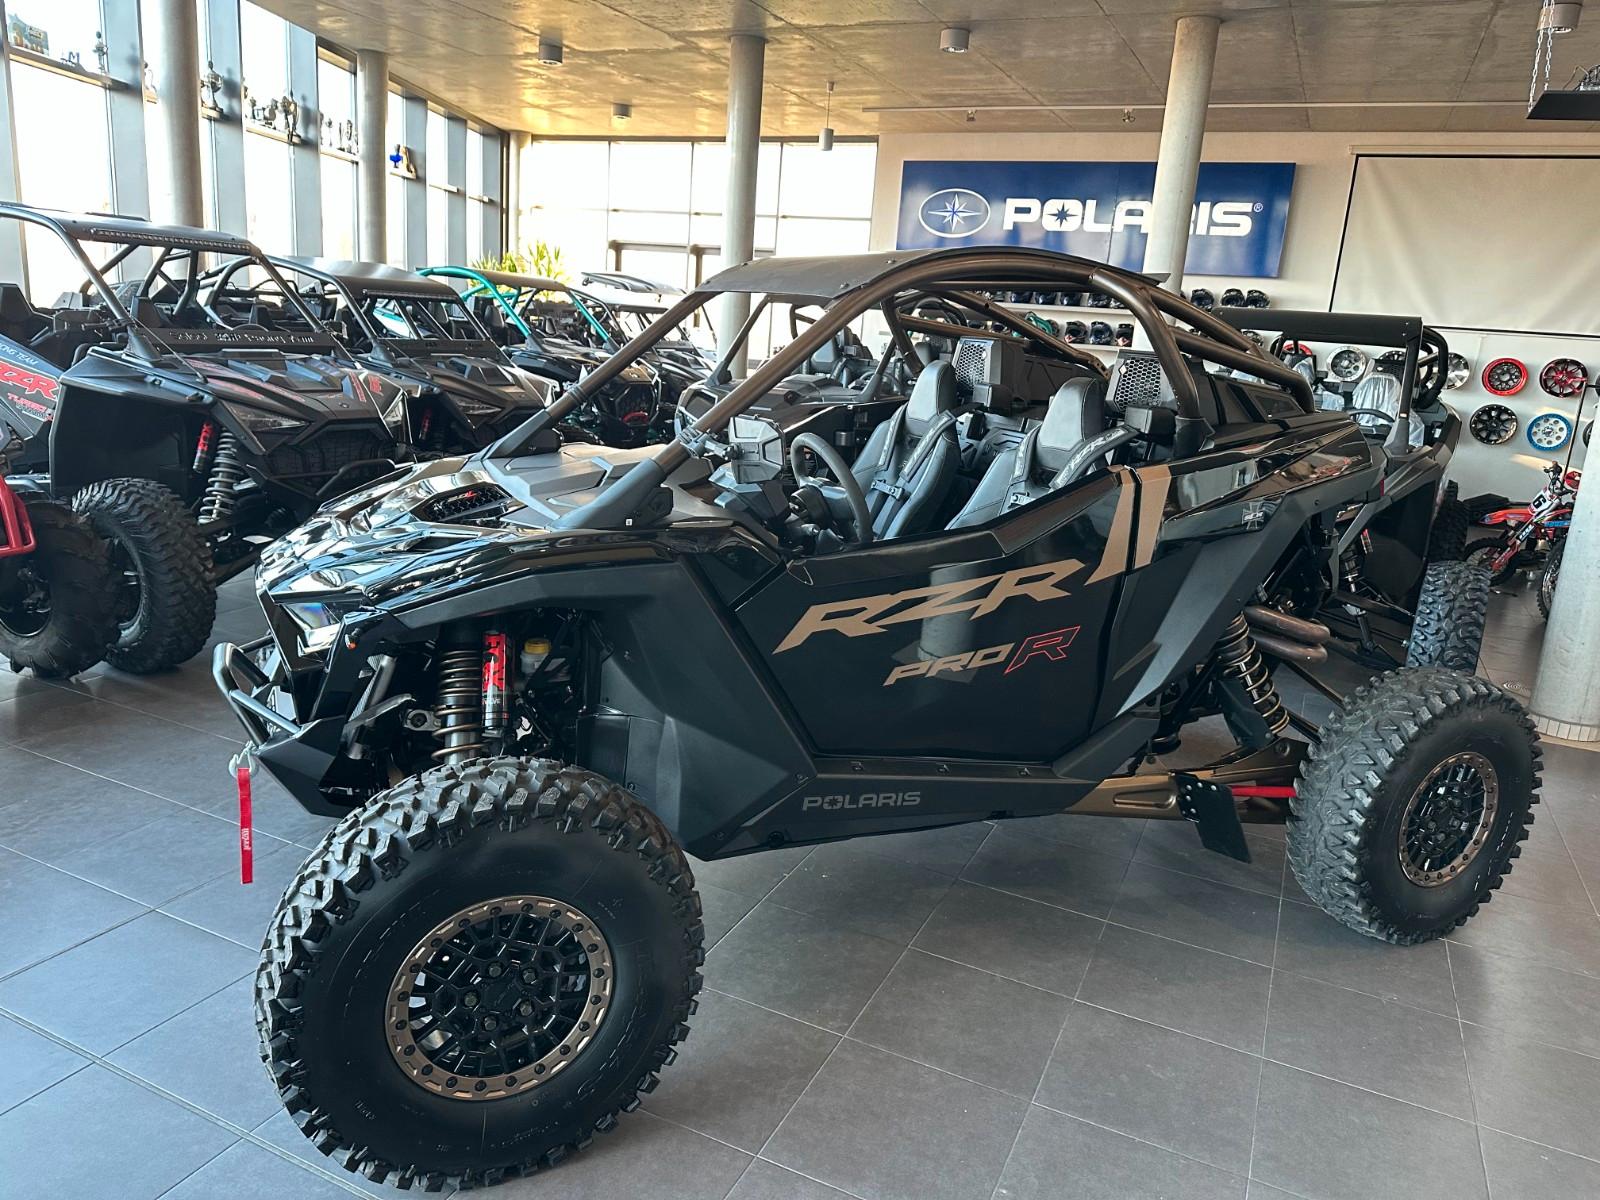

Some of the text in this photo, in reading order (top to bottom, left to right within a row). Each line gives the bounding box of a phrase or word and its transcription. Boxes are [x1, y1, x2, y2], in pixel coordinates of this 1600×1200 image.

[773, 559, 1085, 655] RZR
[883, 625, 1081, 687] PRO R
[802, 792, 921, 811] POLARIS
